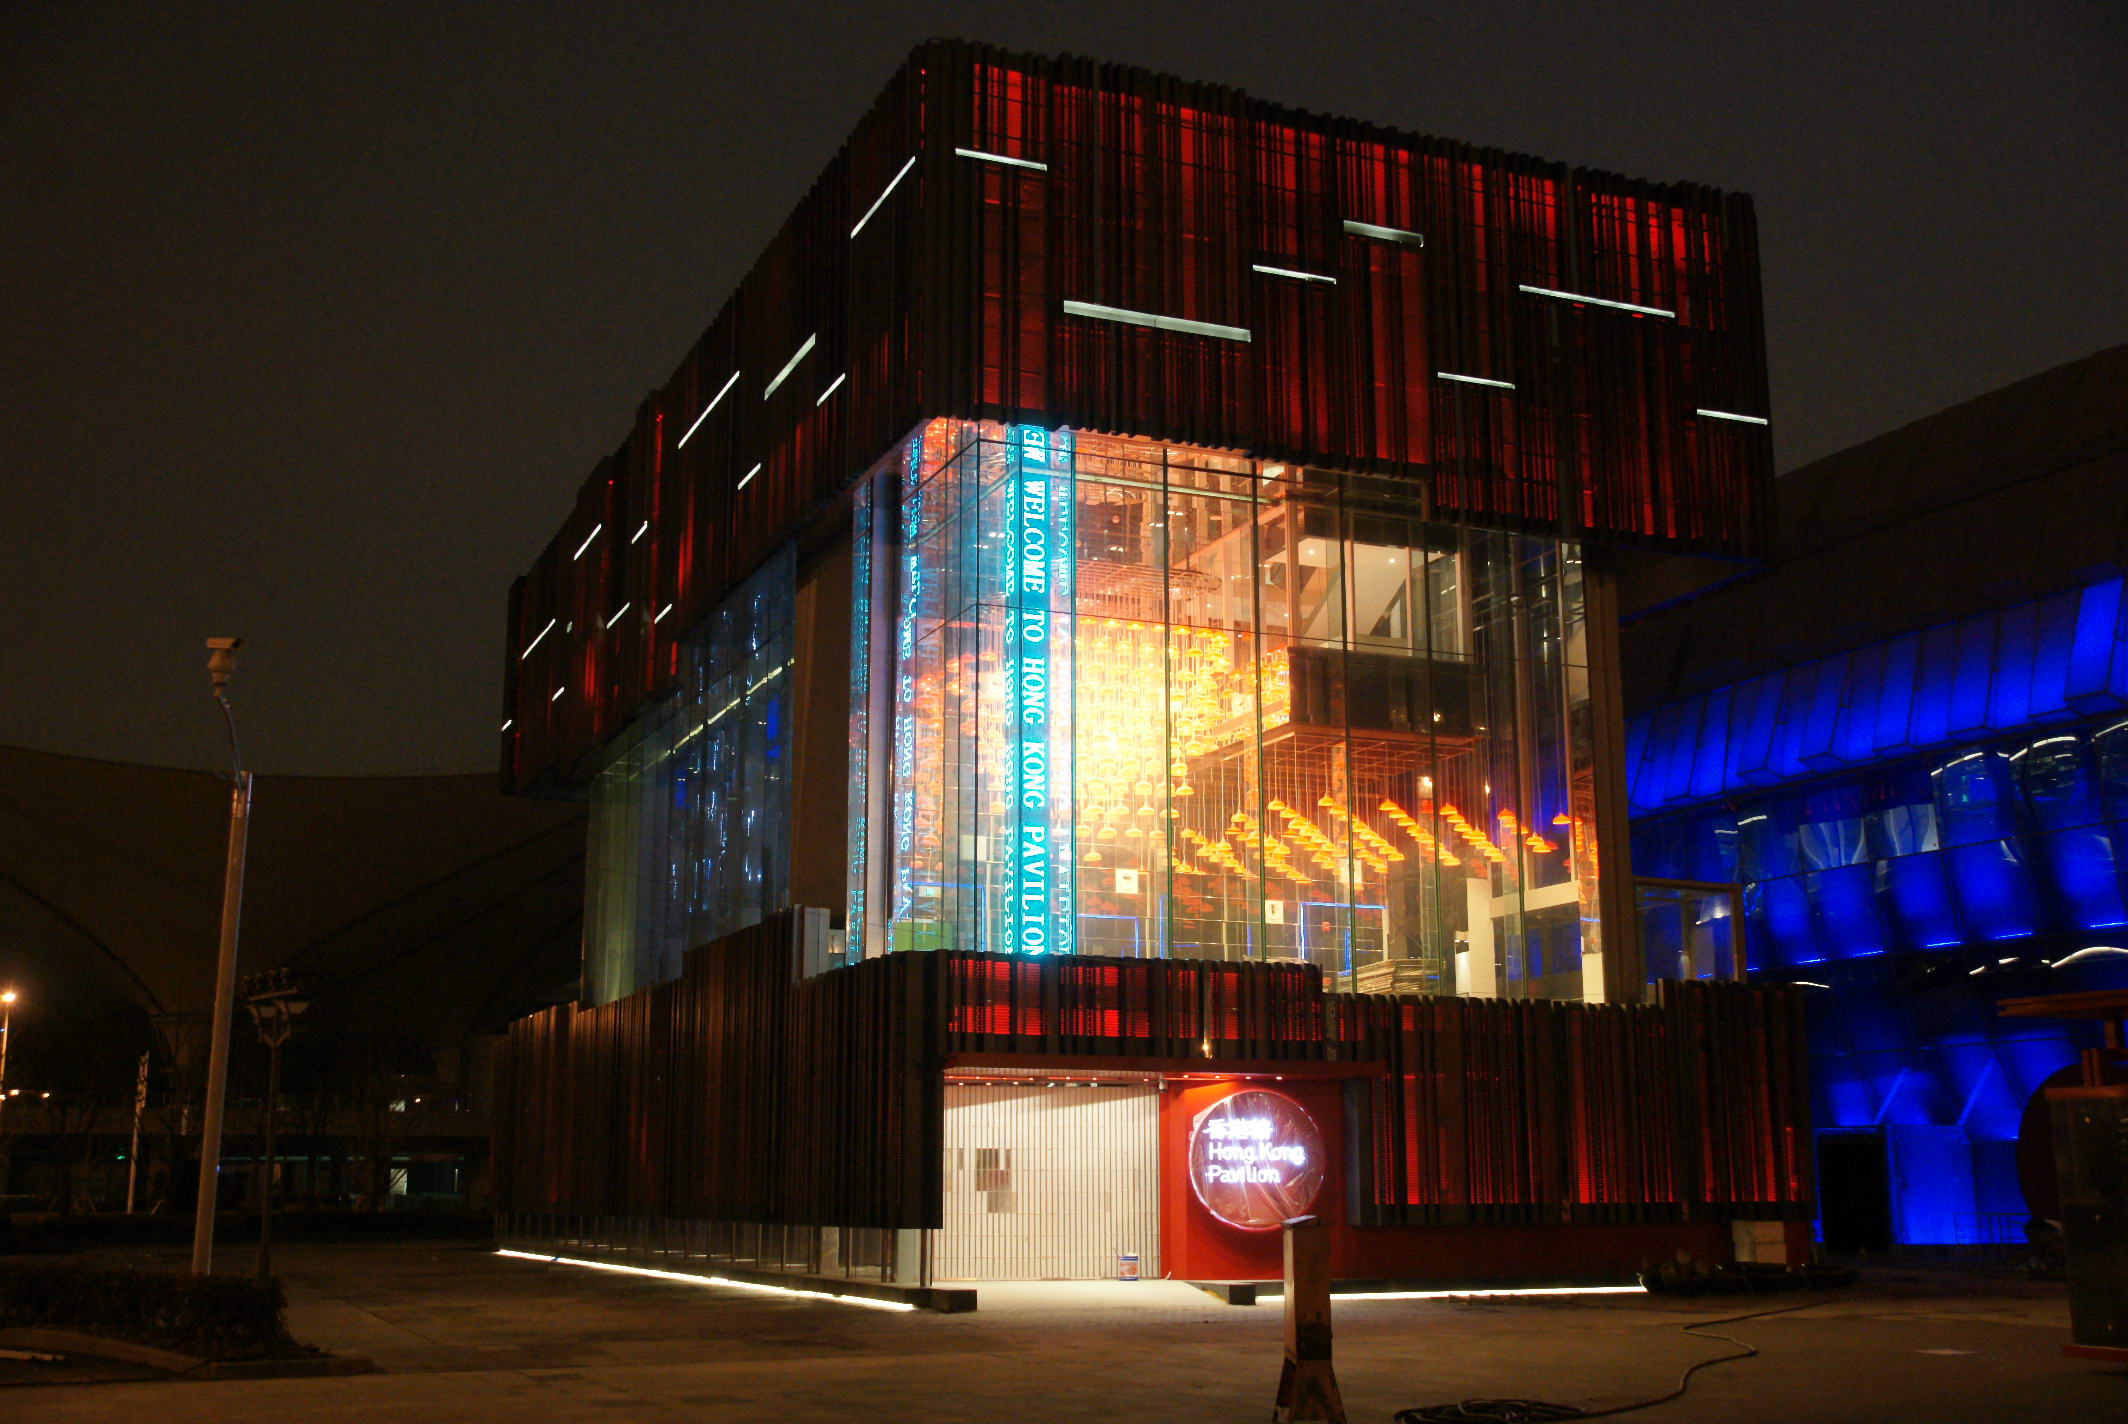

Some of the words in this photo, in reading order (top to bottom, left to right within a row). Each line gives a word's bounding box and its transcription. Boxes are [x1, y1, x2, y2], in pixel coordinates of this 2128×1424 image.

[1022, 480, 1046, 594] WELCOME
[1022, 609, 1046, 643] TO
[1022, 657, 1046, 725] HONG
[1022, 740, 1046, 809] KONG
[1207, 1165, 1281, 1184] Pavilion
[1208, 1141, 1256, 1164] Hong
[1259, 1141, 1306, 1165] Kong
